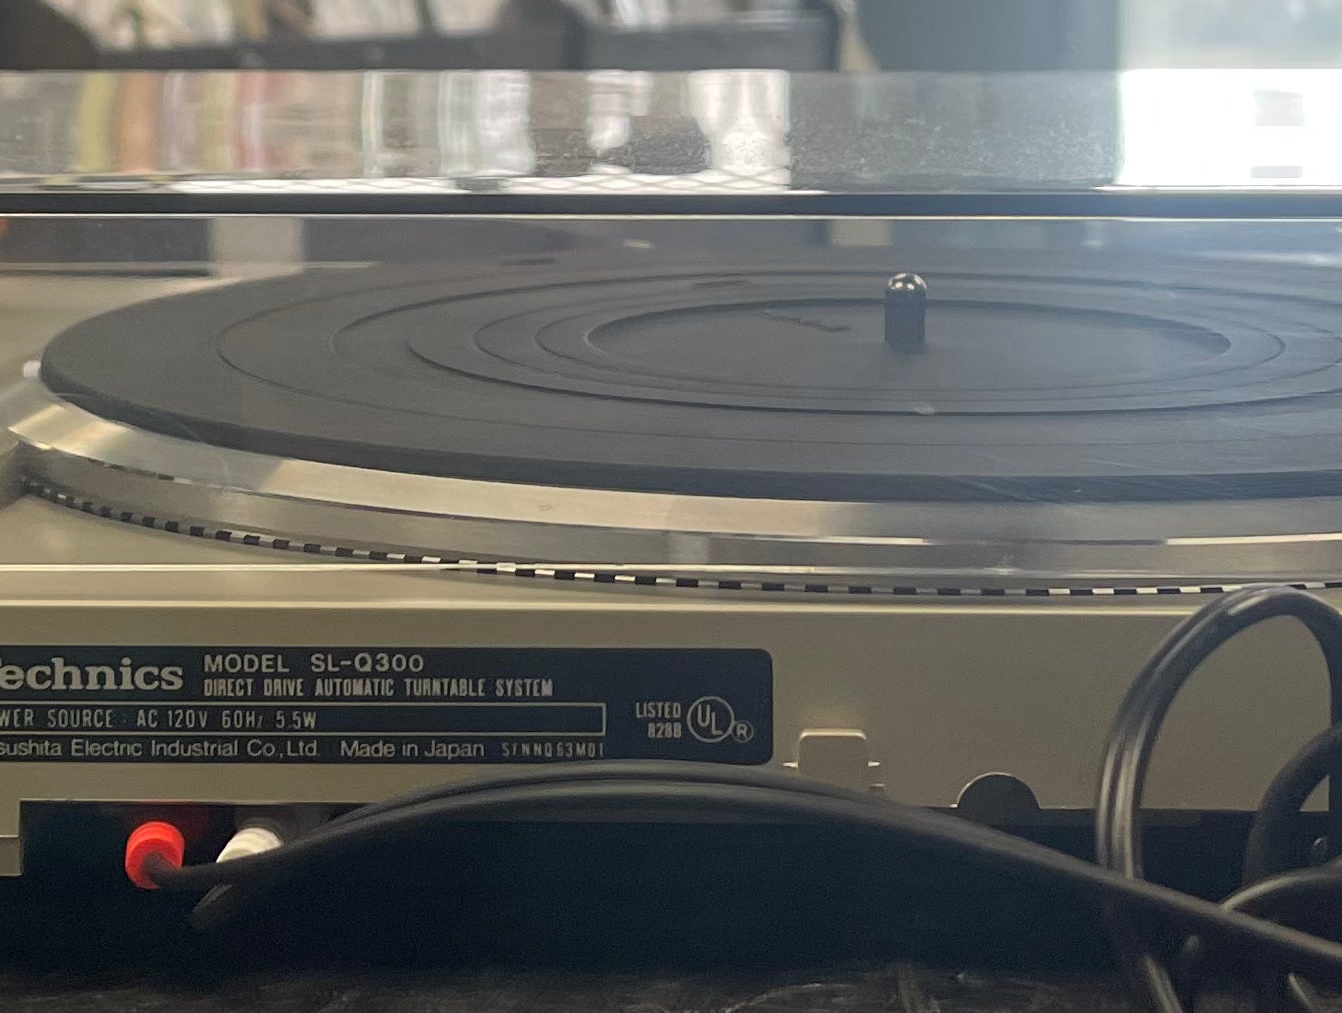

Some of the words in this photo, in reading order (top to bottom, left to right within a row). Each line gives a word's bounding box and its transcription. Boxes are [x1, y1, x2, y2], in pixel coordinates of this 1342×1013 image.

[203, 654, 290, 673] MODEL
[311, 653, 424, 673] SL-Q300
[203, 679, 253, 696] DIRECT
[264, 679, 304, 696] DRIVE
[315, 679, 394, 697] AUTOMATIC
[404, 679, 485, 697] TURNTABLE
[496, 679, 553, 697] SYSTEM
[137, 710, 158, 728] AC
[167, 710, 208, 729] 120V
[635, 702, 681, 719] LISTED
[71, 738, 142, 757] Electric
[151, 739, 238, 757] Industrial
[341, 740, 395, 757] Made
[402, 740, 418, 757] in
[425, 741, 485, 760] Japan
